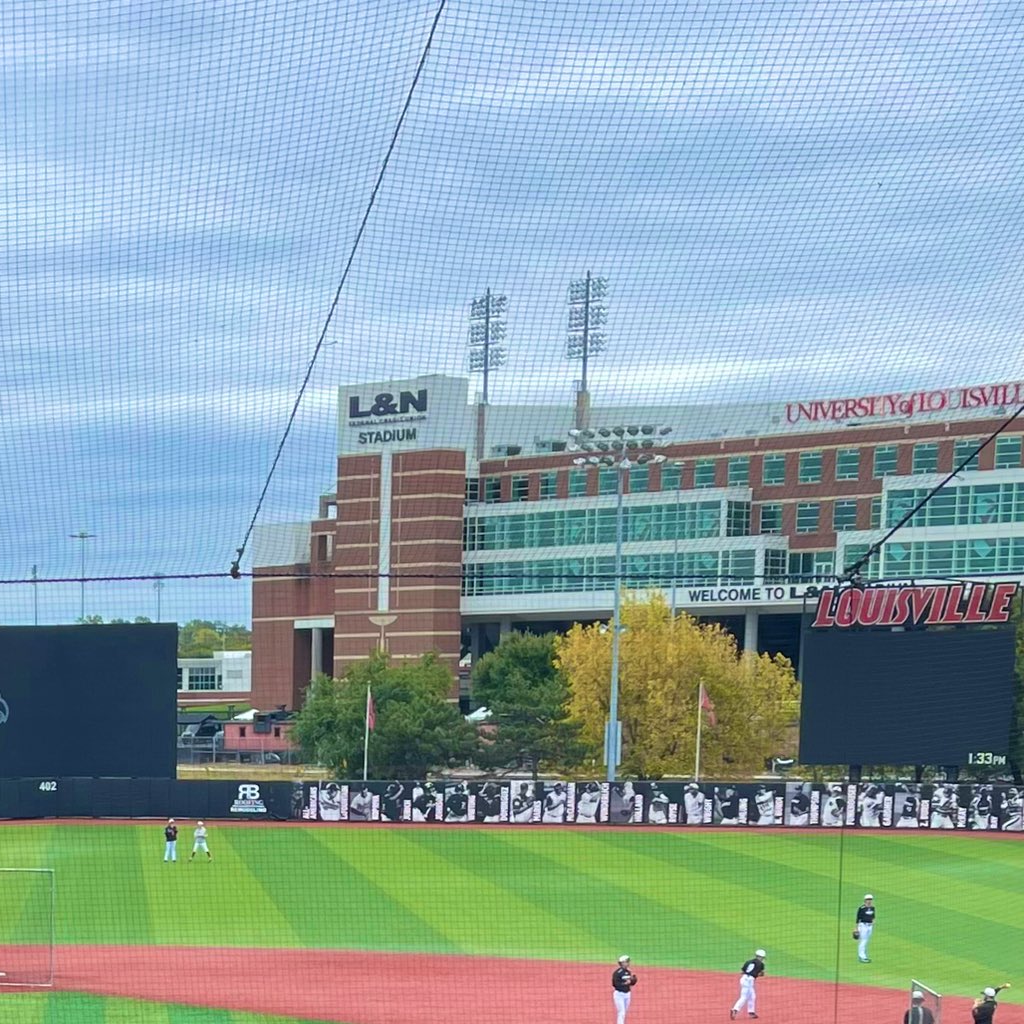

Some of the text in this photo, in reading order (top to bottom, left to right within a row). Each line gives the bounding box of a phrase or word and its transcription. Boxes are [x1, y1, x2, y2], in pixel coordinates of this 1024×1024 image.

[349, 389, 427, 418] L&N
[785, 394, 900, 423] UNIVERSITY
[358, 428, 416, 444] STADIUM
[689, 587, 761, 603] WELCOME
[765, 587, 784, 600] TO
[812, 582, 1019, 628] LOUISVILLE
[39, 781, 58, 791] 402
